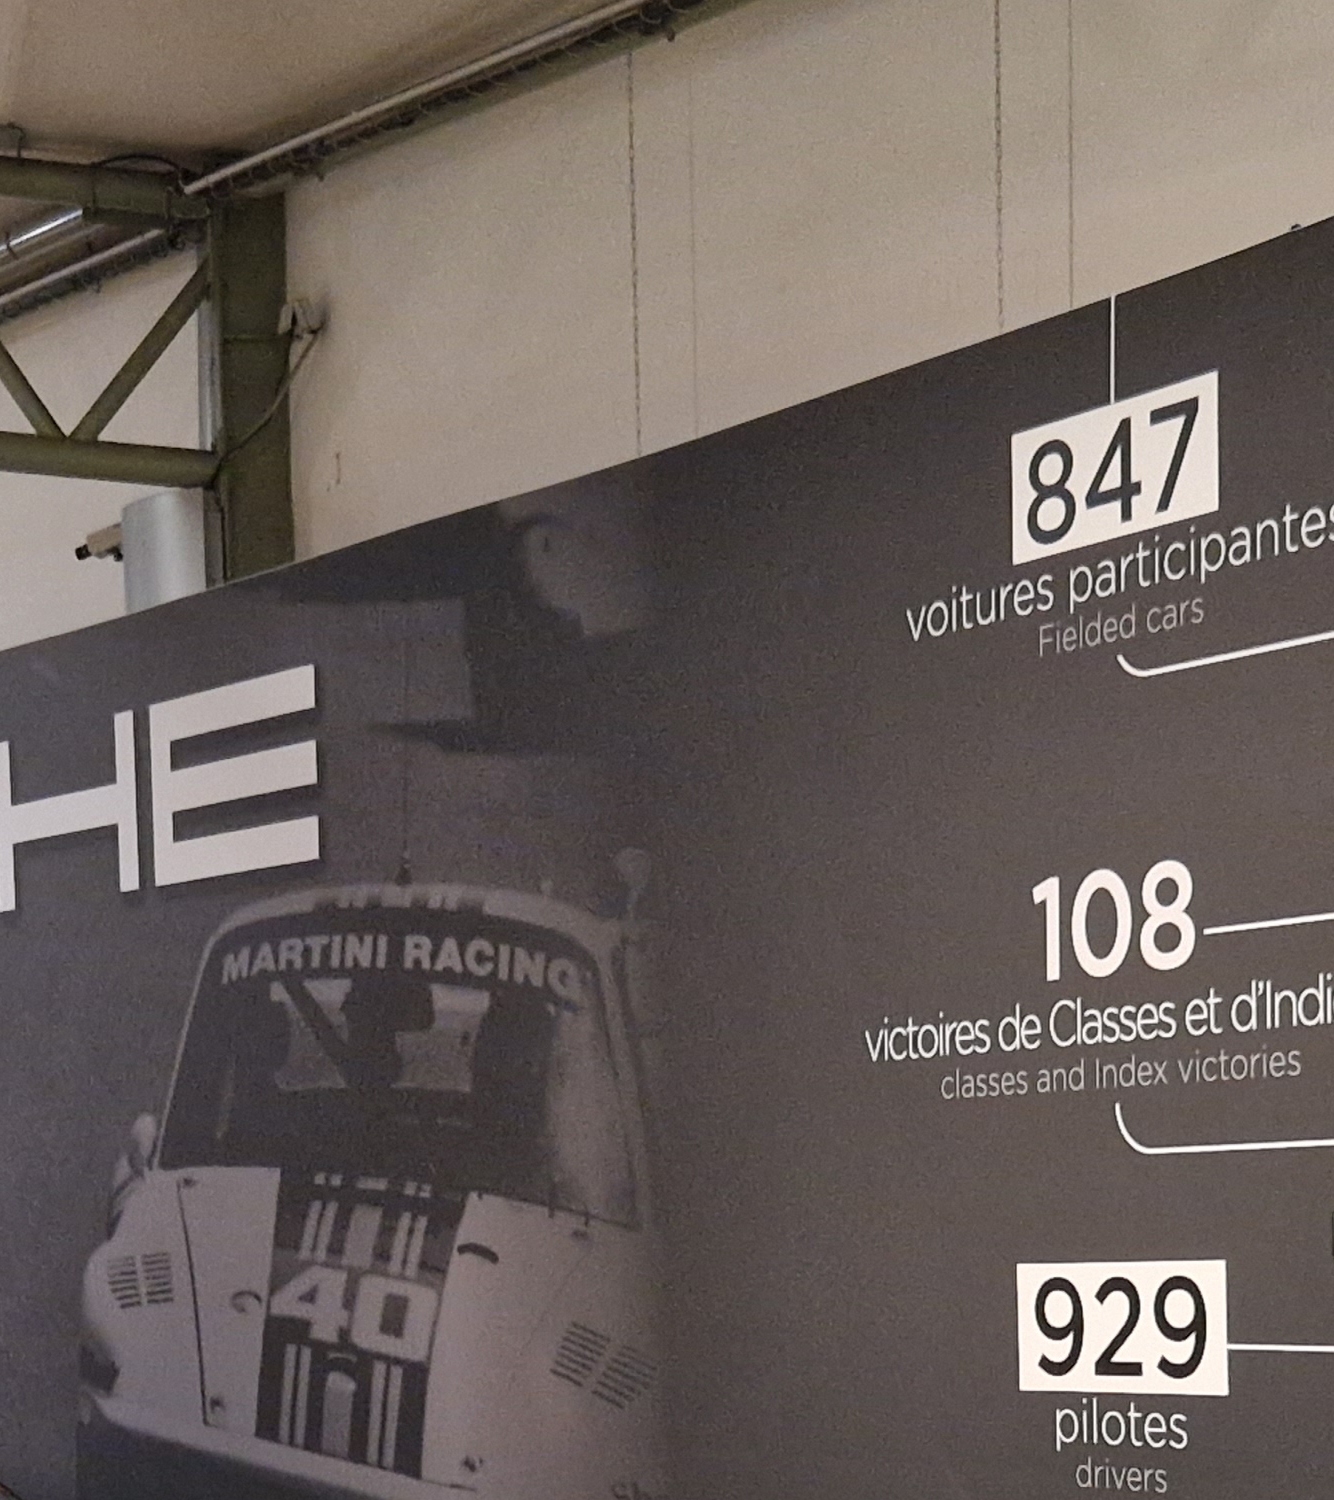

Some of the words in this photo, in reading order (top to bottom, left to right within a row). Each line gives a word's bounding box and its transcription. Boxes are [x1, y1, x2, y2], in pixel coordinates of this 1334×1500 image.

[1027, 396, 1199, 544] 847
[907, 575, 1053, 642] voitures
[1040, 612, 1135, 657] Fielded
[1147, 598, 1204, 633] cars
[1033, 860, 1195, 981] 108
[221, 934, 387, 985] MARTINI
[404, 935, 577, 995] RACING
[865, 1012, 990, 1061] victoires
[999, 1003, 1041, 1051] de
[1050, 997, 1176, 1047] Classes
[1186, 988, 1222, 1035] et
[941, 1068, 1028, 1099] classes
[1037, 1058, 1084, 1092] and
[1096, 1054, 1168, 1088] Index
[1178, 1050, 1301, 1083] victories
[271, 1263, 441, 1363] 40
[1035, 1276, 1206, 1379] 929
[1056, 1397, 1187, 1451] pilotes
[1076, 1456, 1167, 1493] drivers
